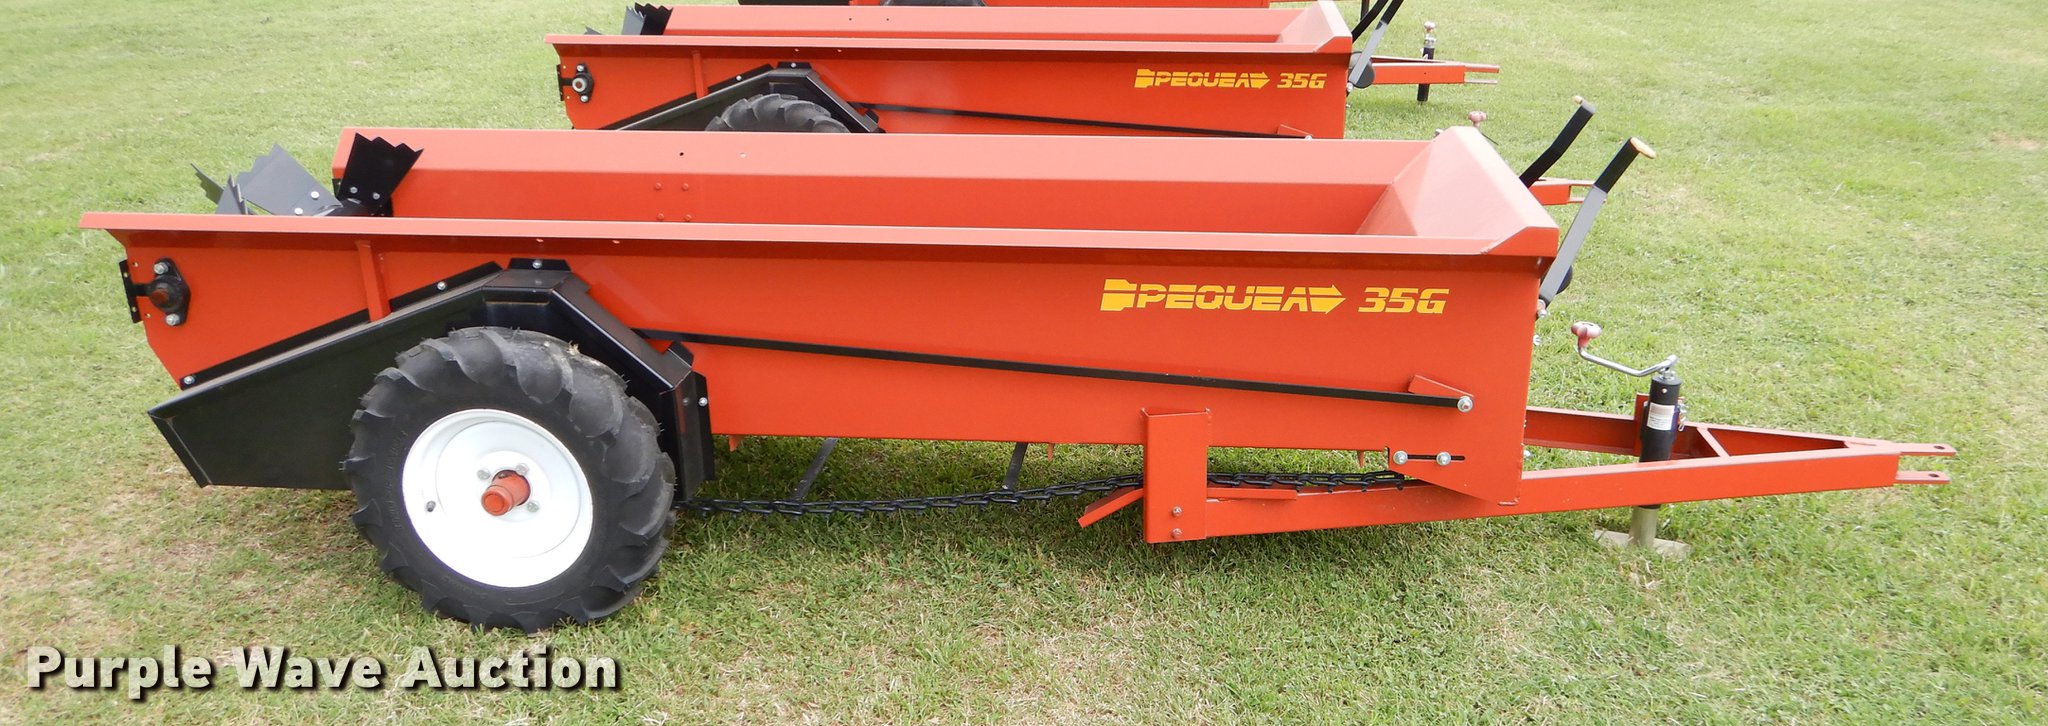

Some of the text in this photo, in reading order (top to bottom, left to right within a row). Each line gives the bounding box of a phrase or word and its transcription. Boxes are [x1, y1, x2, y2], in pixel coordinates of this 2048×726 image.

[1154, 71, 1328, 89] PEQUEA 35G
[1137, 283, 1450, 314] PEQUEA 35G
